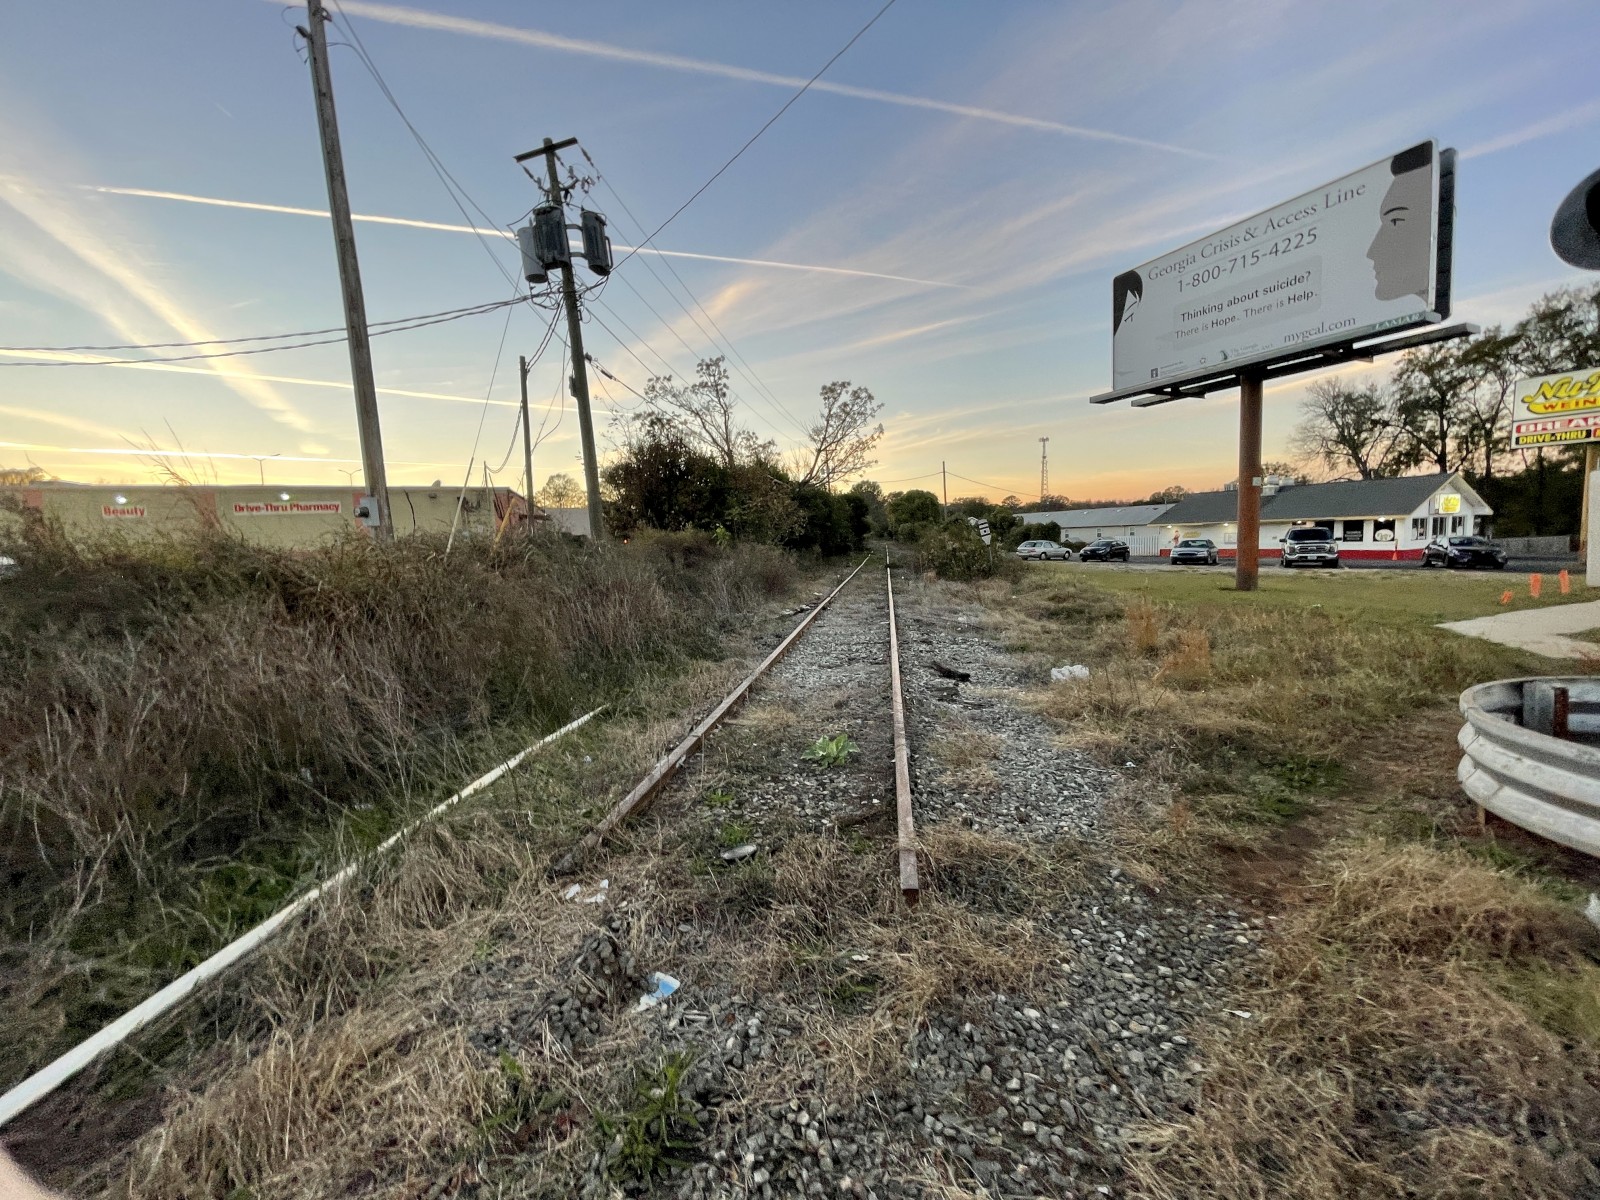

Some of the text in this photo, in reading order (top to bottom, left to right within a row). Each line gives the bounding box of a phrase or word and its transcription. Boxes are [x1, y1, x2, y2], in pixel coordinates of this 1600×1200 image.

[1148, 184, 1366, 280] Georgia Crisis & Access Line
[1178, 226, 1317, 292] 1-800-715-4225
[1175, 290, 1318, 339] There is Hope. There is Help.
[1180, 271, 1311, 322] Thinking about suicide?
[1283, 317, 1356, 343] mygcal.com
[1519, 430, 1587, 445] DRIVE-THRU
[103, 505, 145, 517] Beauty
[290, 502, 340, 512] Pharmacy
